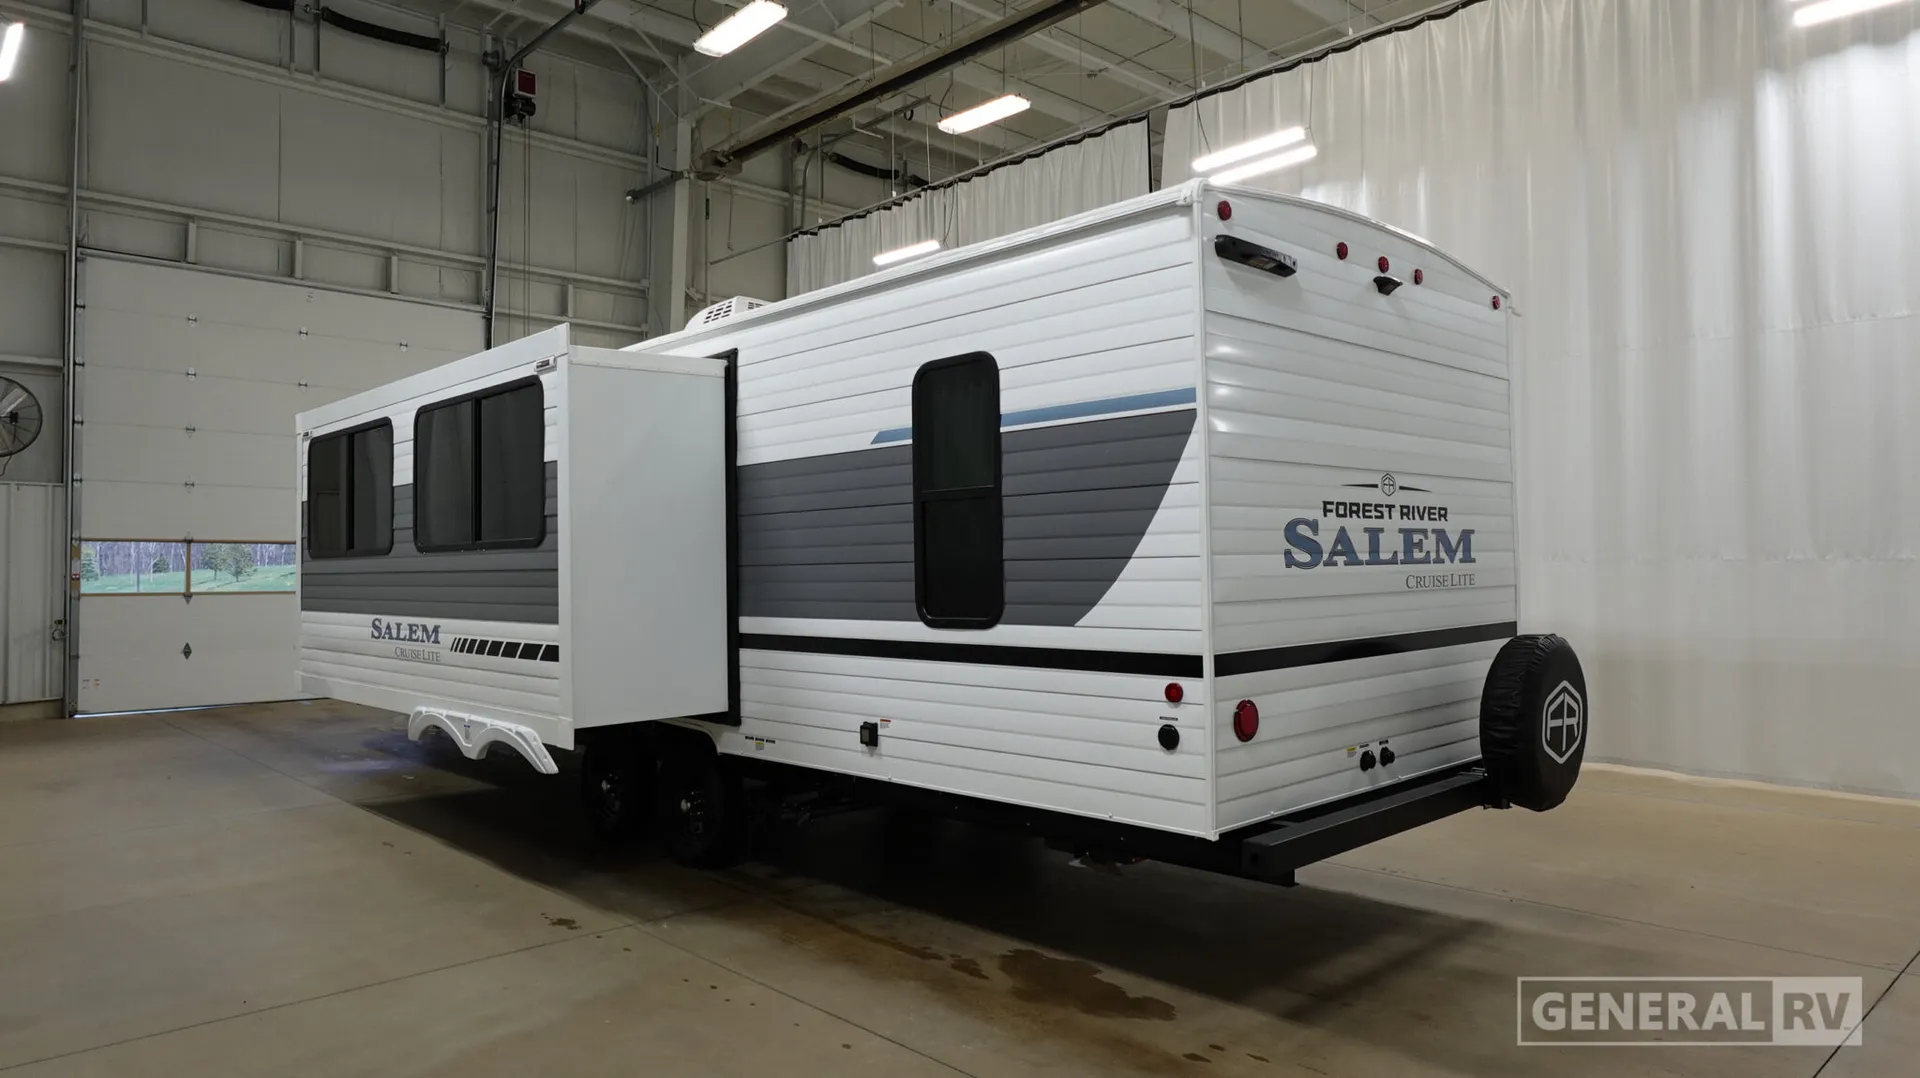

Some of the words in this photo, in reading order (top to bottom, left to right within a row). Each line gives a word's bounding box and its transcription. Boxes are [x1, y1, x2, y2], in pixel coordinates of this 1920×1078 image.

[1322, 501, 1395, 520] FOREST
[1399, 504, 1448, 522] RIVER
[1283, 517, 1476, 570] SALEM
[370, 618, 441, 644] SALEM
